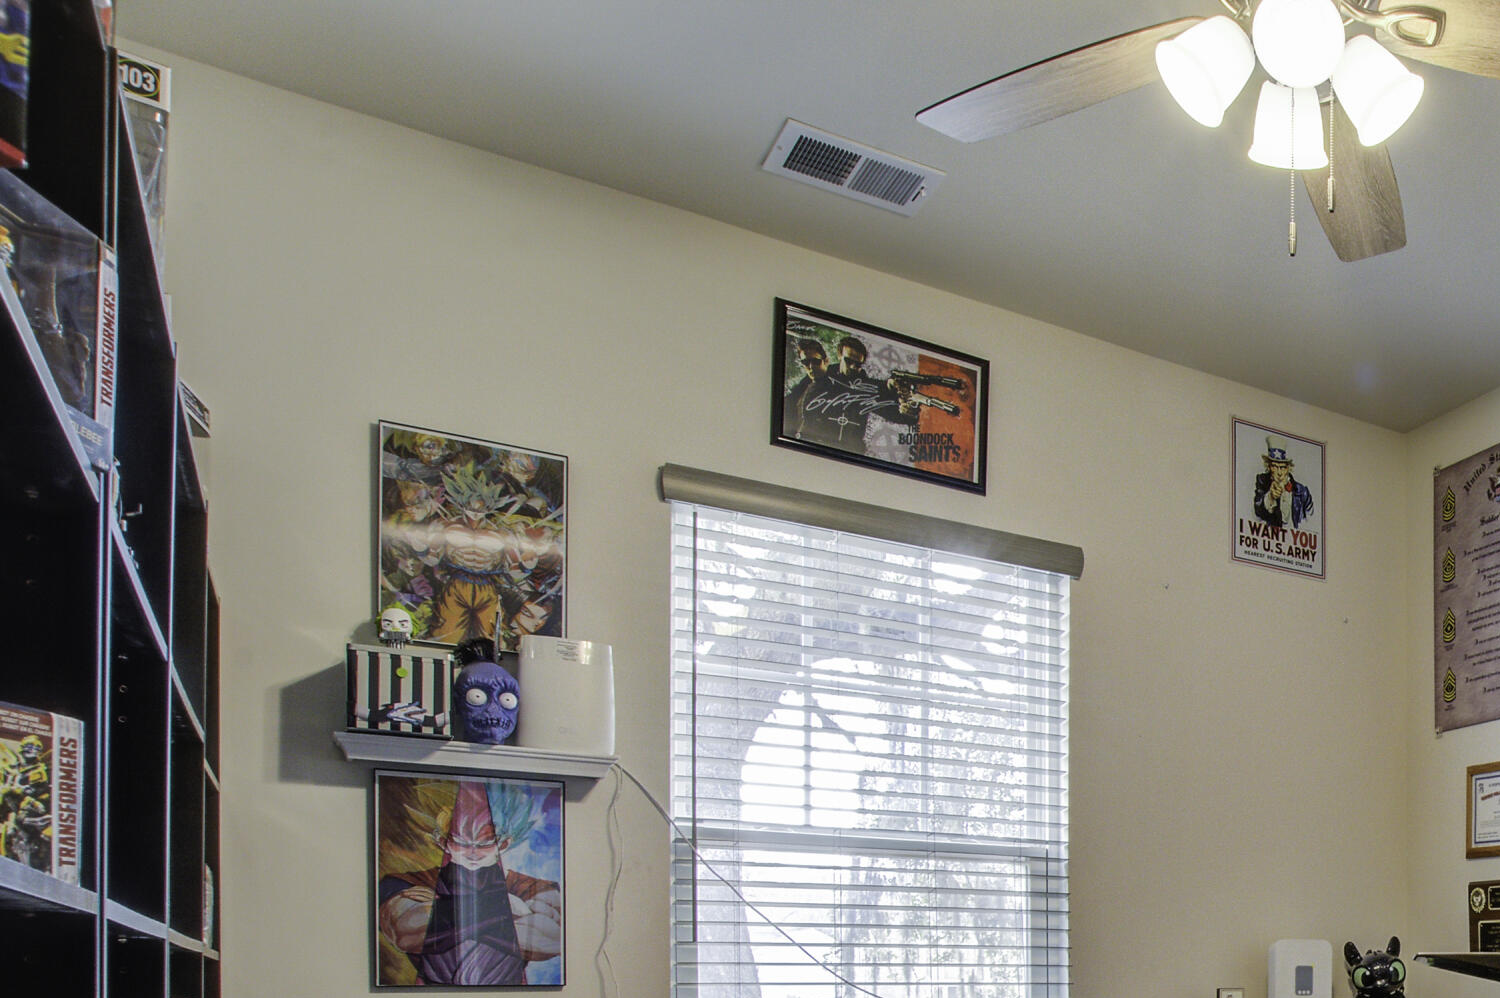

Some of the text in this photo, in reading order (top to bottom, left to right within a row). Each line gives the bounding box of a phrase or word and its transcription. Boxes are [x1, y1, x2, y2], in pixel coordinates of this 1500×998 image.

[119, 63, 156, 91] 103
[101, 289, 117, 408] TRANSFORMERS
[898, 433, 954, 446] BOONDOCK
[908, 424, 921, 433] THE
[908, 444, 961, 463] SAINTS
[1464, 463, 1487, 495] United
[1239, 518, 1317, 550] I WANT YOU
[1239, 535, 1317, 562] FOR U.S. ARMY
[1244, 550, 1313, 569] NEAREST RECRUITING STATION
[59, 737, 77, 867] TRANSFORMERS
